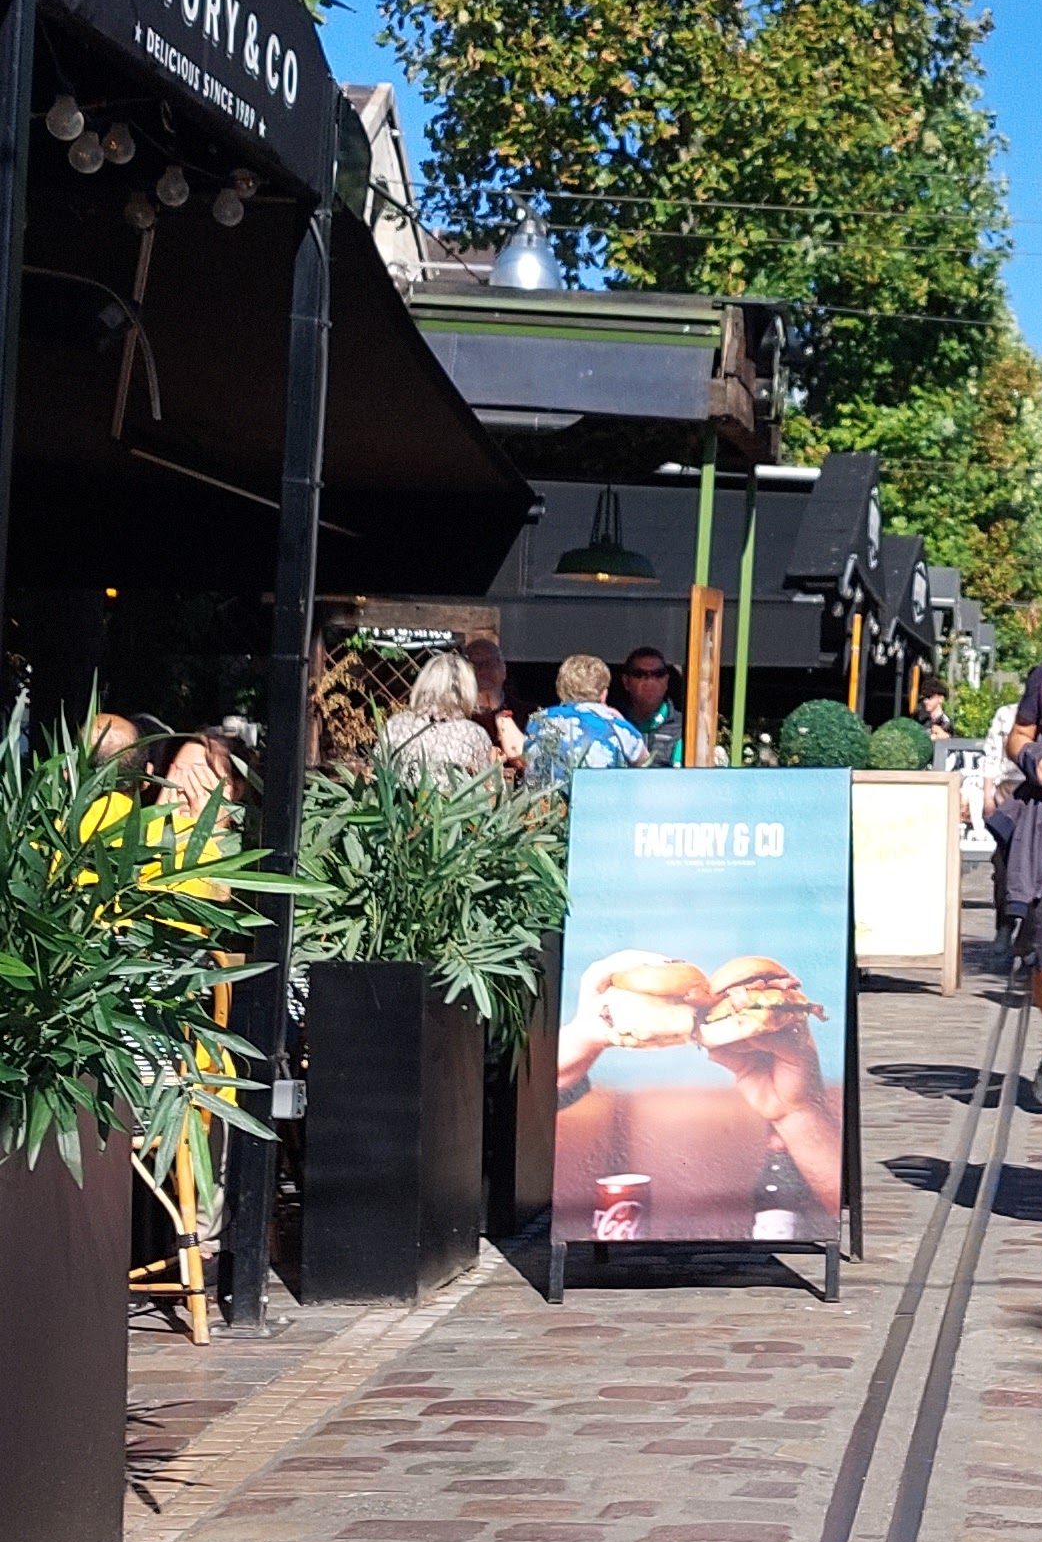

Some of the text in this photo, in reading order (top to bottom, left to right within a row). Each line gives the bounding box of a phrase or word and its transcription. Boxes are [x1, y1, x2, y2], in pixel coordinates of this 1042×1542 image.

[145, 26, 257, 132] DELICIOUS SINCE 1989
[243, 13, 261, 79] &
[265, 33, 299, 109] CO
[634, 822, 785, 858] FACTORY & CO
